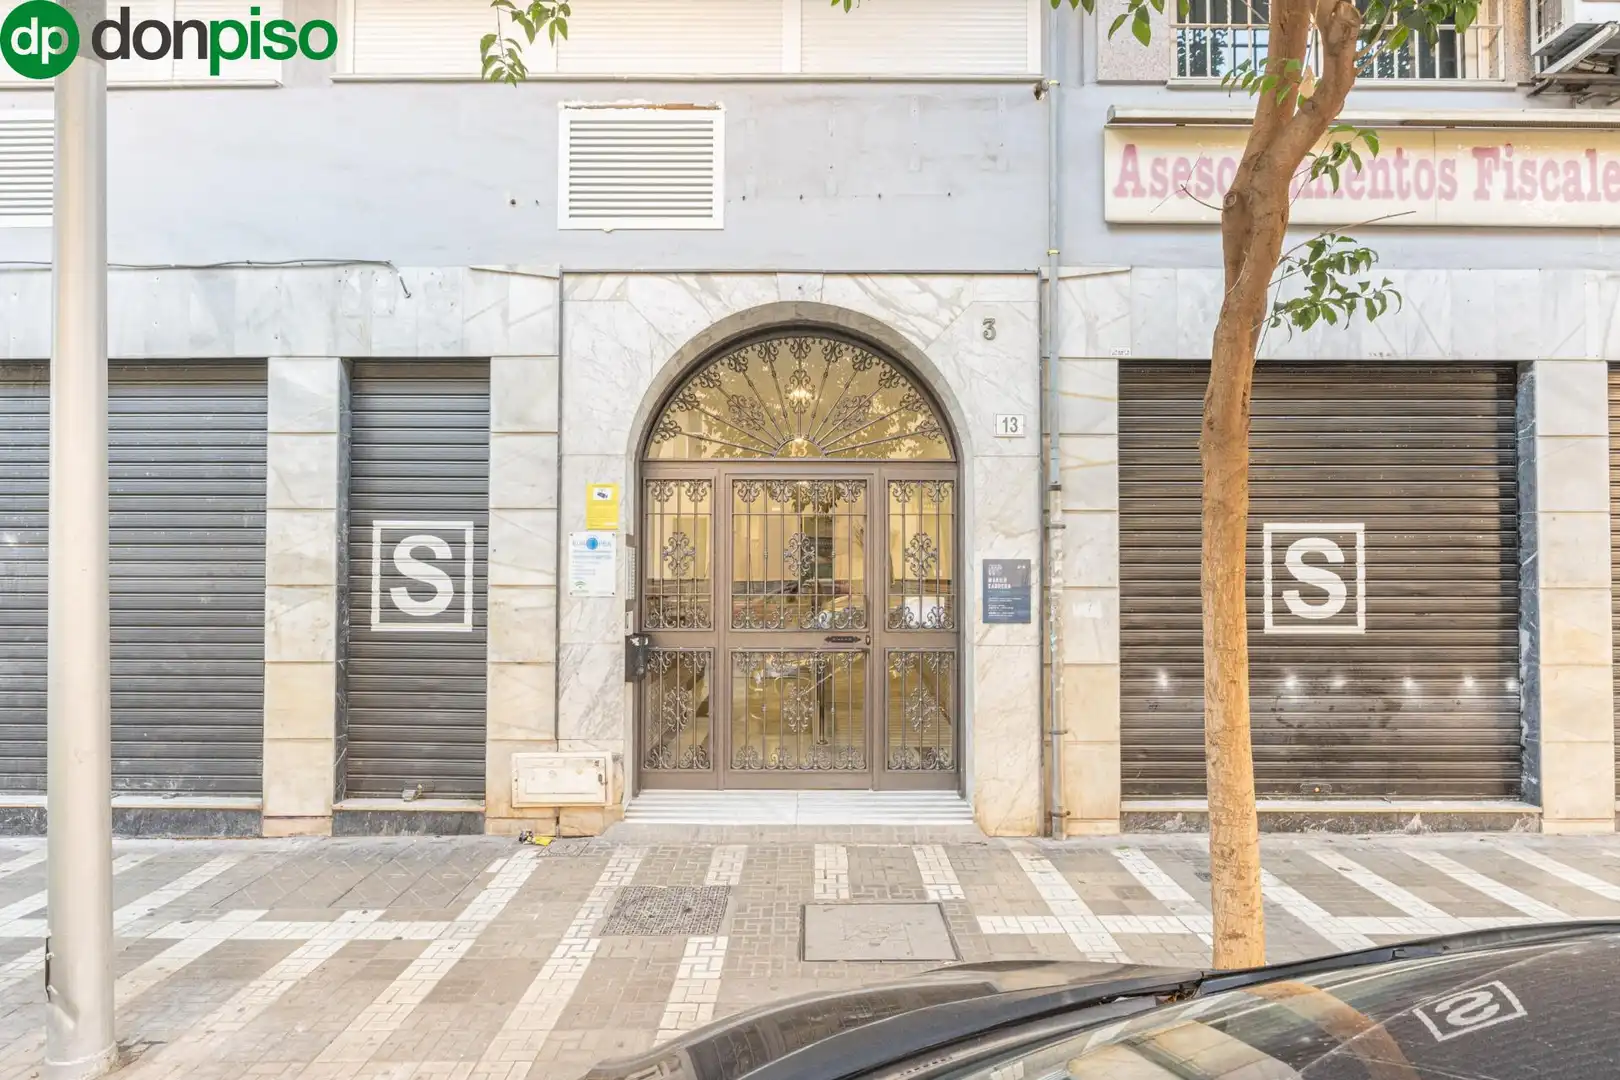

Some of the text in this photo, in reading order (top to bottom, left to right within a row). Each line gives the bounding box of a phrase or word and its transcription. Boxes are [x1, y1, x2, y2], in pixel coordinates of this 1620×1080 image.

[982, 317, 997, 341] 3
[1002, 416, 1019, 433] 13
[389, 534, 455, 616] S
[1282, 537, 1348, 619] S
